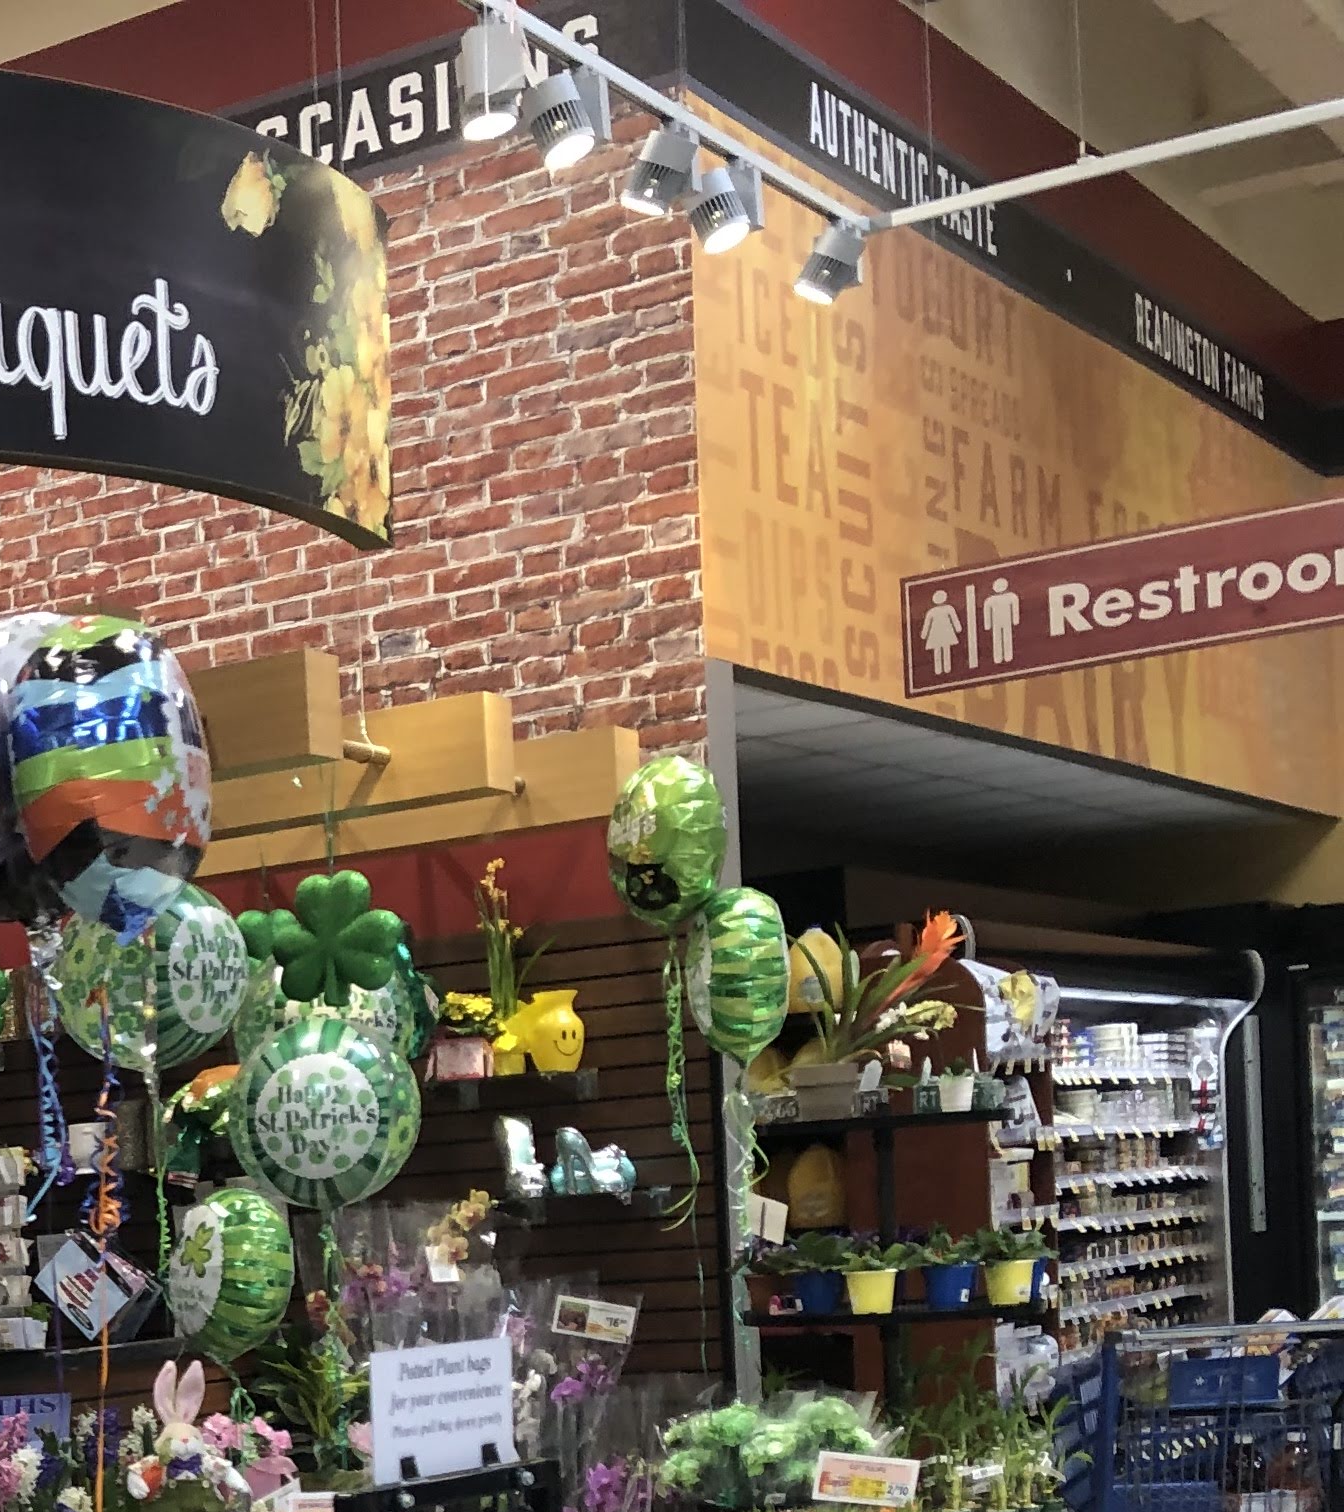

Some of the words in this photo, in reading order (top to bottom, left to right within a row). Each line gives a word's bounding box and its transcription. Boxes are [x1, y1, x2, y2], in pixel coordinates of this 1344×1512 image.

[809, 82, 932, 205] AUTHENTIC
[1134, 291, 1221, 393] READINGTON
[1224, 349, 1265, 422] FARMS
[738, 368, 833, 520] TEA
[952, 425, 1061, 546] FARM
[1047, 549, 1344, 637] Restroo
